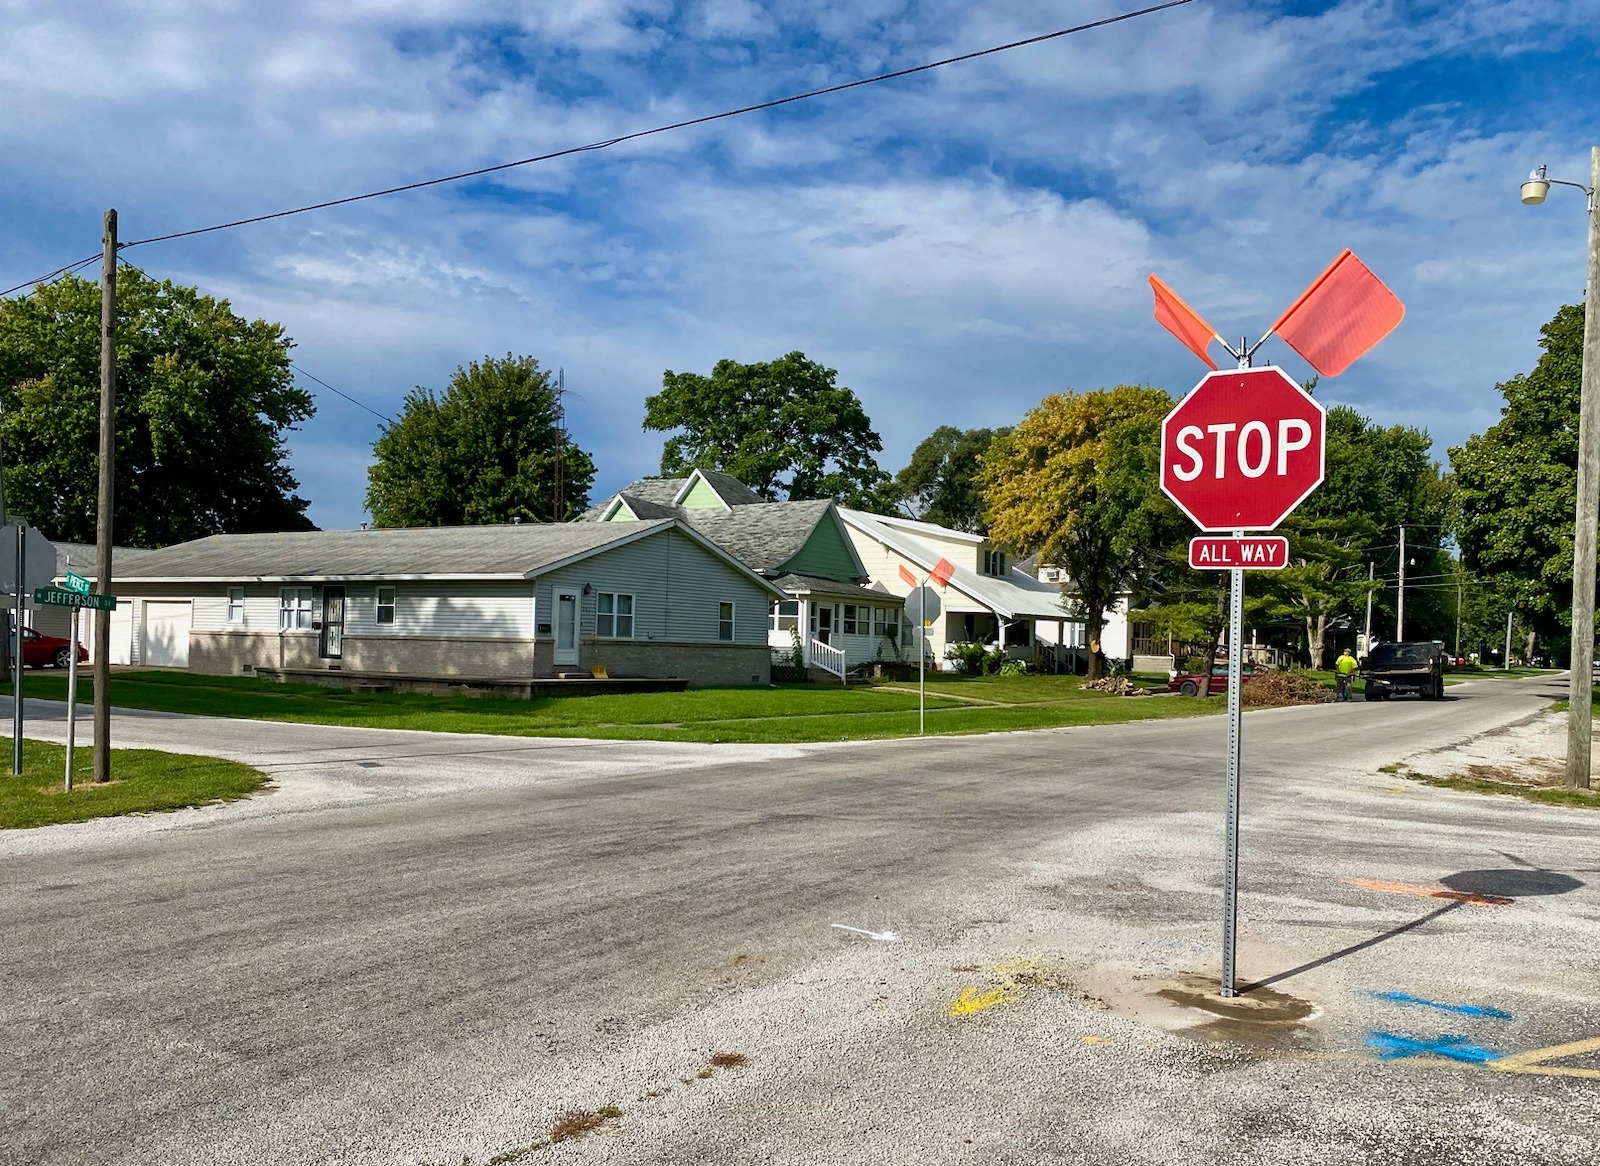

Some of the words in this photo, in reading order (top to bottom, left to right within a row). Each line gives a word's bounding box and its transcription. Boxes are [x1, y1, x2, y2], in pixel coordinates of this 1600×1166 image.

[1172, 418, 1312, 482] STOP
[1199, 544, 1232, 562] ALL
[1240, 543, 1278, 562] WAY
[44, 591, 100, 607] JEFFERSON
